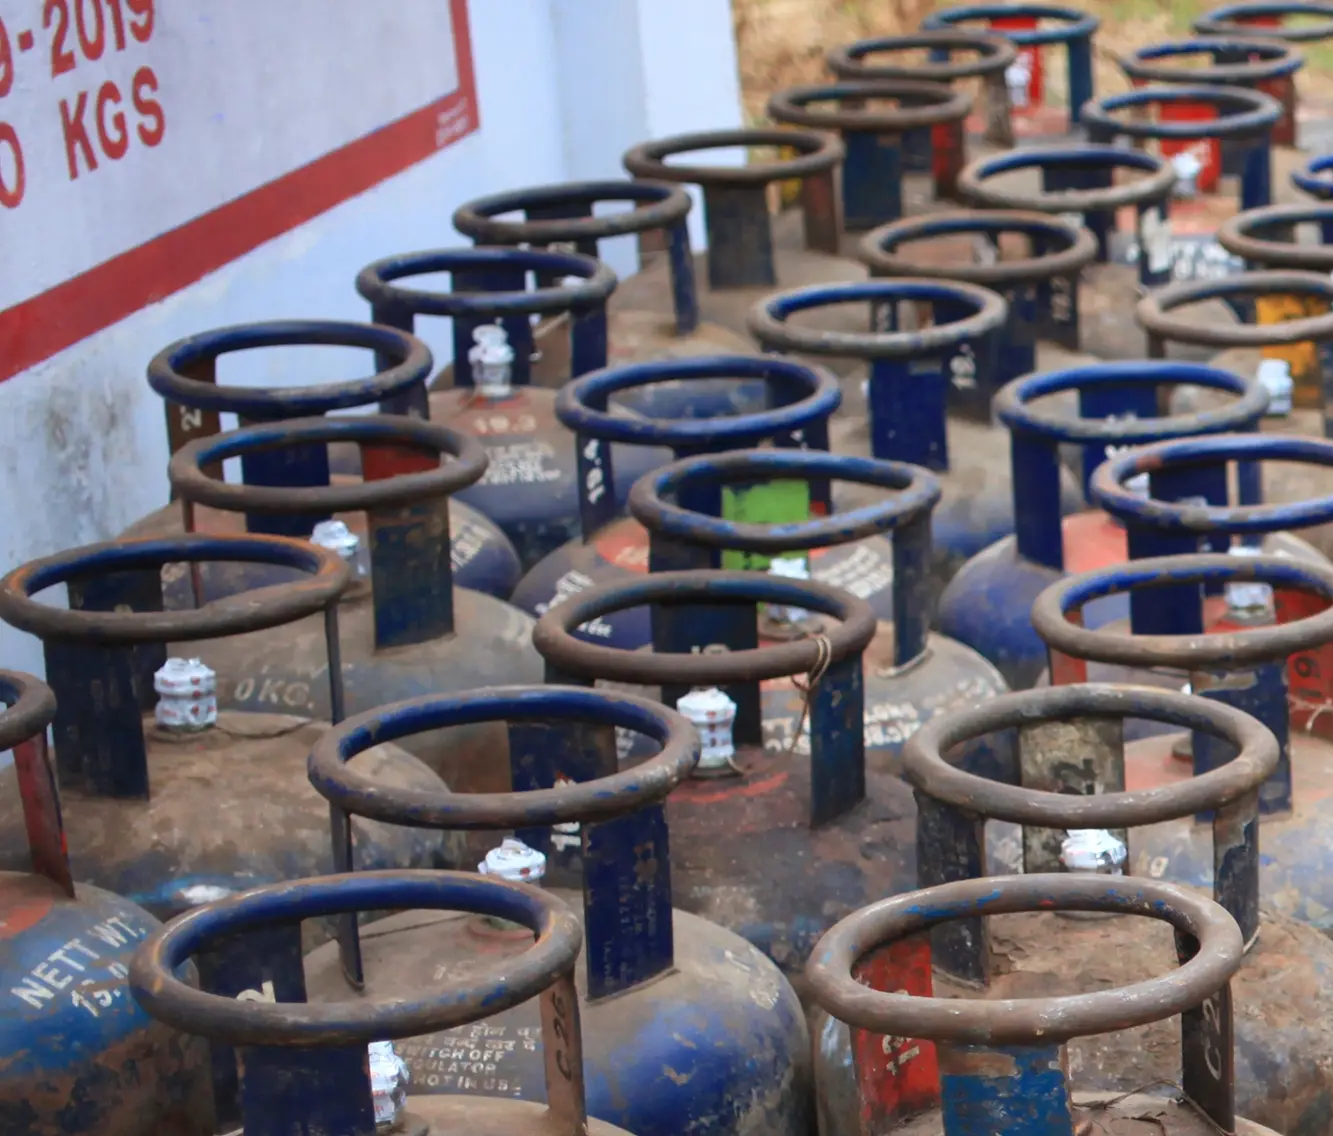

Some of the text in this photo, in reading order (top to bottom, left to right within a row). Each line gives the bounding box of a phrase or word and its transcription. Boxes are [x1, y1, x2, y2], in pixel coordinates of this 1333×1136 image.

[58, 65, 166, 181] KGS
[10, 915, 147, 1010] NETT WT.
[403, 1055, 498, 1078] EGULATOR
[468, 1048, 507, 1063] OFF
